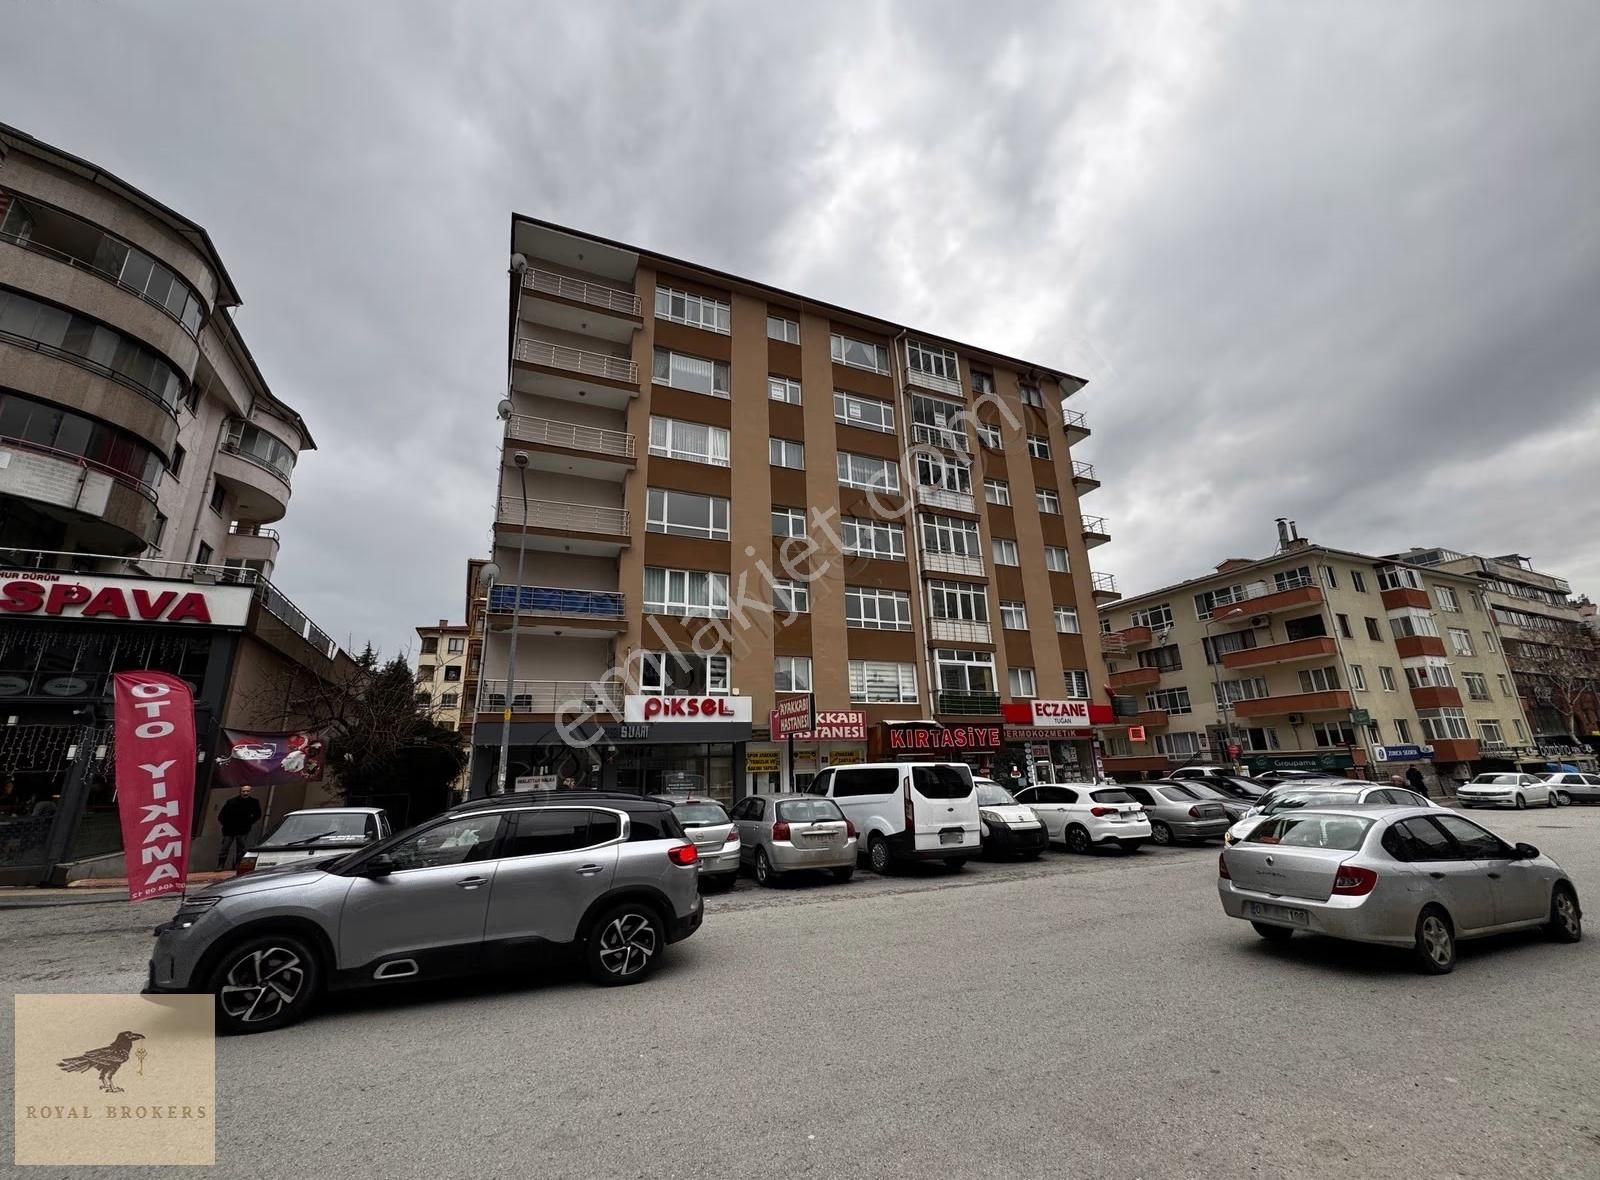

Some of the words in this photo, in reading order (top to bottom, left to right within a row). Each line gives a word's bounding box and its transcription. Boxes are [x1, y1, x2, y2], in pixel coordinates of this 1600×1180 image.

[22, 572, 60, 582] DÜRÜM
[779, 697, 809, 716] AYAKKABI
[1034, 702, 1087, 717] ECZANE
[815, 712, 863, 724] KKABI
[890, 726, 1002, 749] KIRTASİYE
[1273, 758, 1317, 768] Groupama
